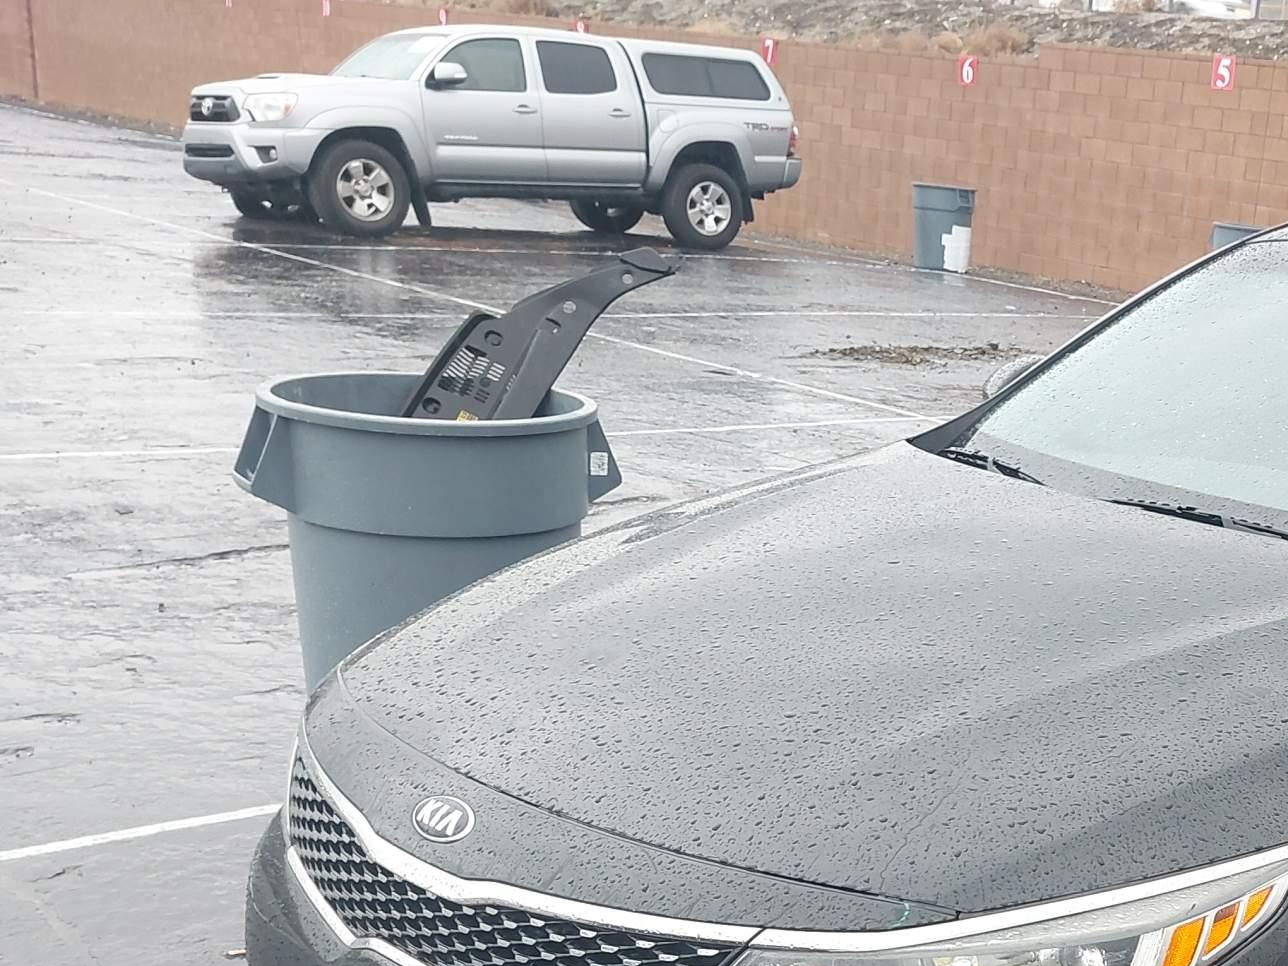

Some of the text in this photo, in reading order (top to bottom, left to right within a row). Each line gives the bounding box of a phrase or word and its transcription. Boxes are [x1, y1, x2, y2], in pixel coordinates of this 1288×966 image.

[764, 38, 774, 63] 7
[962, 57, 974, 84] 6
[1216, 57, 1232, 88] 5
[416, 799, 463, 836] KIA
